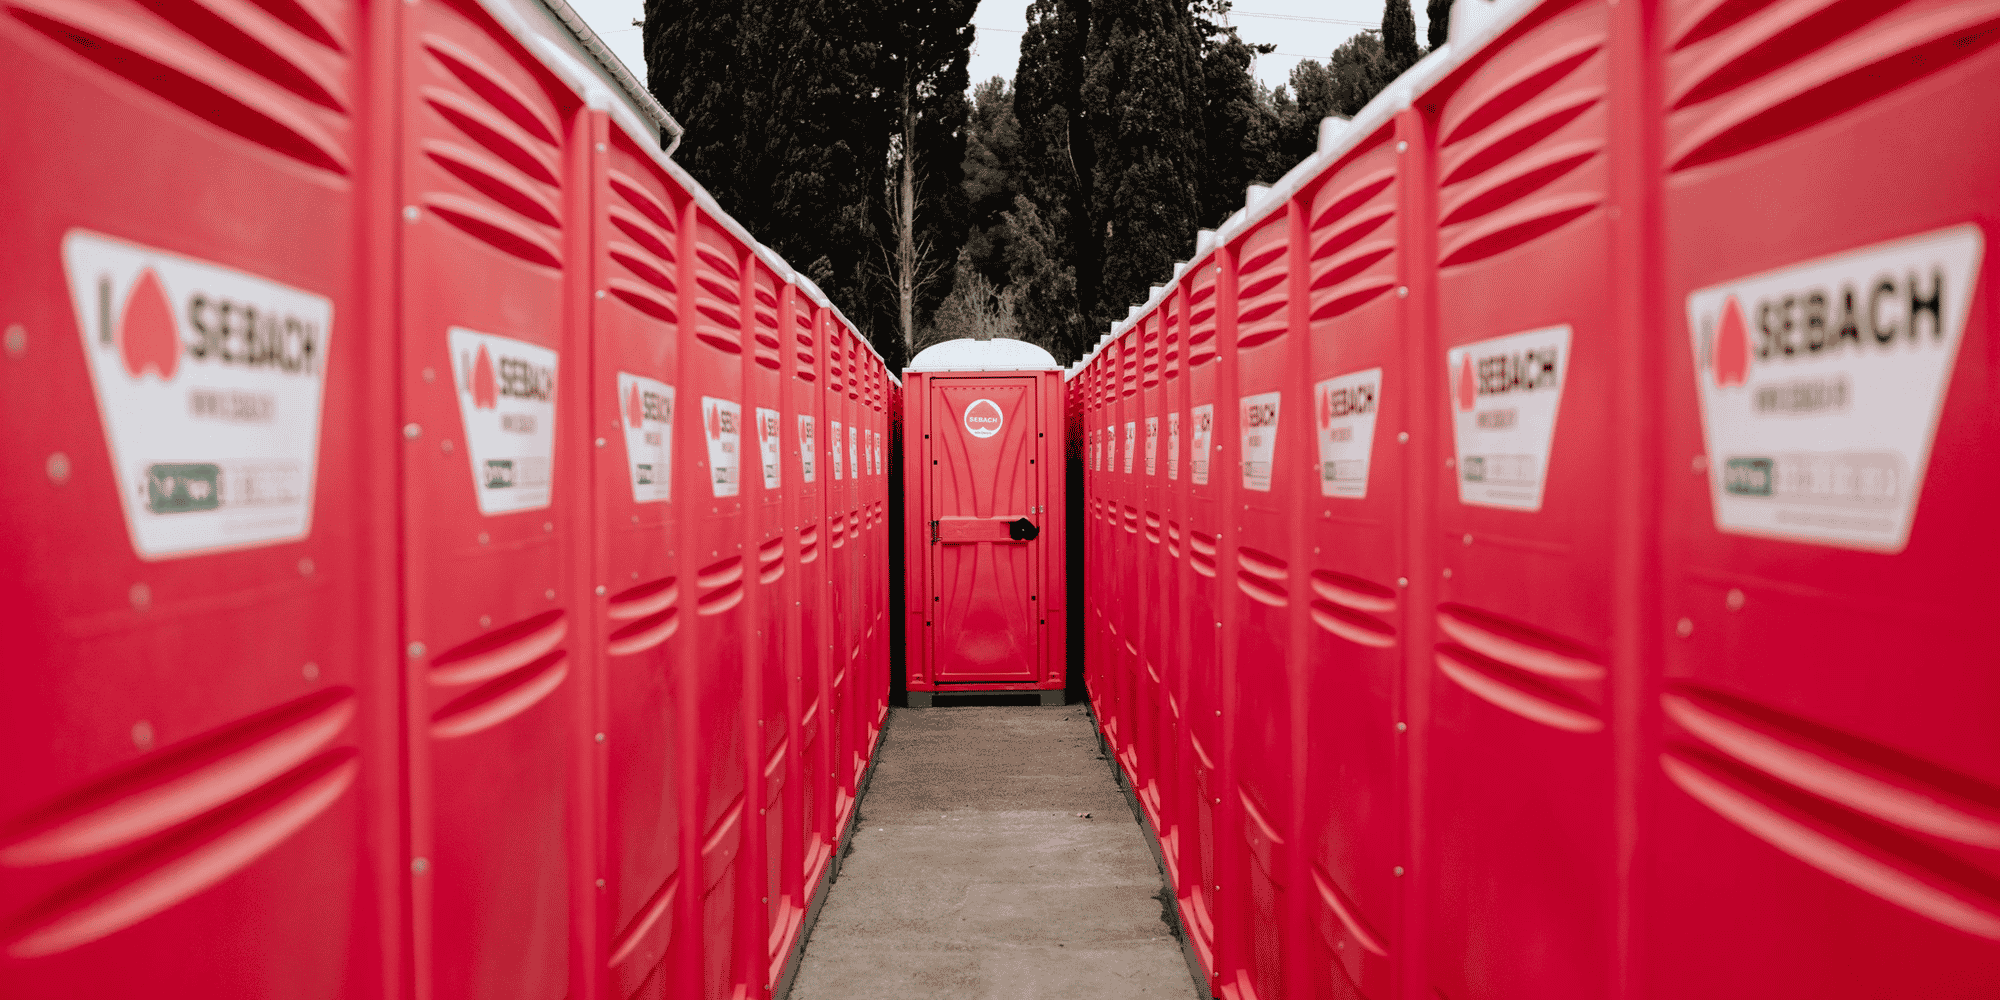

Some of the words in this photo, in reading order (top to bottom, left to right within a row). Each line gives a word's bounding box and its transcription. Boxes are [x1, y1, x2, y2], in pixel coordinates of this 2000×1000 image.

[188, 294, 318, 377] SEBACH
[1756, 264, 1944, 363] SEBACH
[499, 357, 556, 403] SEBACH
[1476, 347, 1558, 397] SEBACH
[1331, 383, 1376, 418] SEBACH
